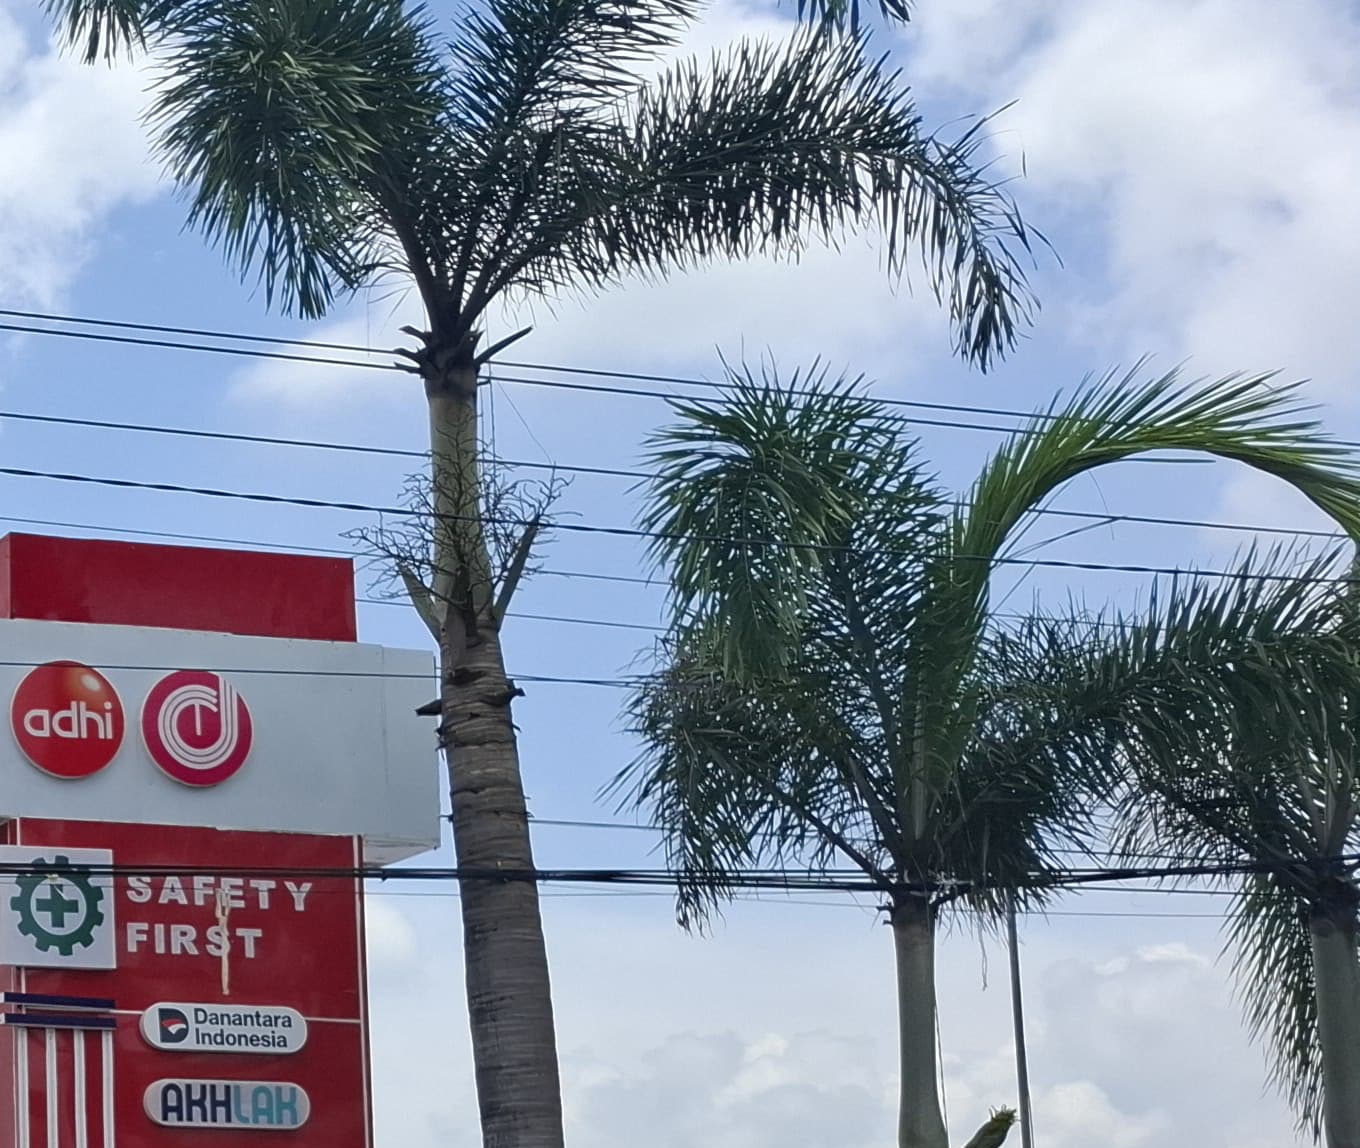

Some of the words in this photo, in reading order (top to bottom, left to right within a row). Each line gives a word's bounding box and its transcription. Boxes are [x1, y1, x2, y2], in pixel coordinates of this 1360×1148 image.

[24, 701, 113, 740] adhi
[126, 876, 313, 911] SAFETY
[126, 922, 263, 958] FIRST
[194, 1008, 292, 1028] Danantara
[195, 1030, 288, 1048] Indonesia
[161, 1083, 298, 1125] AKHLAK
